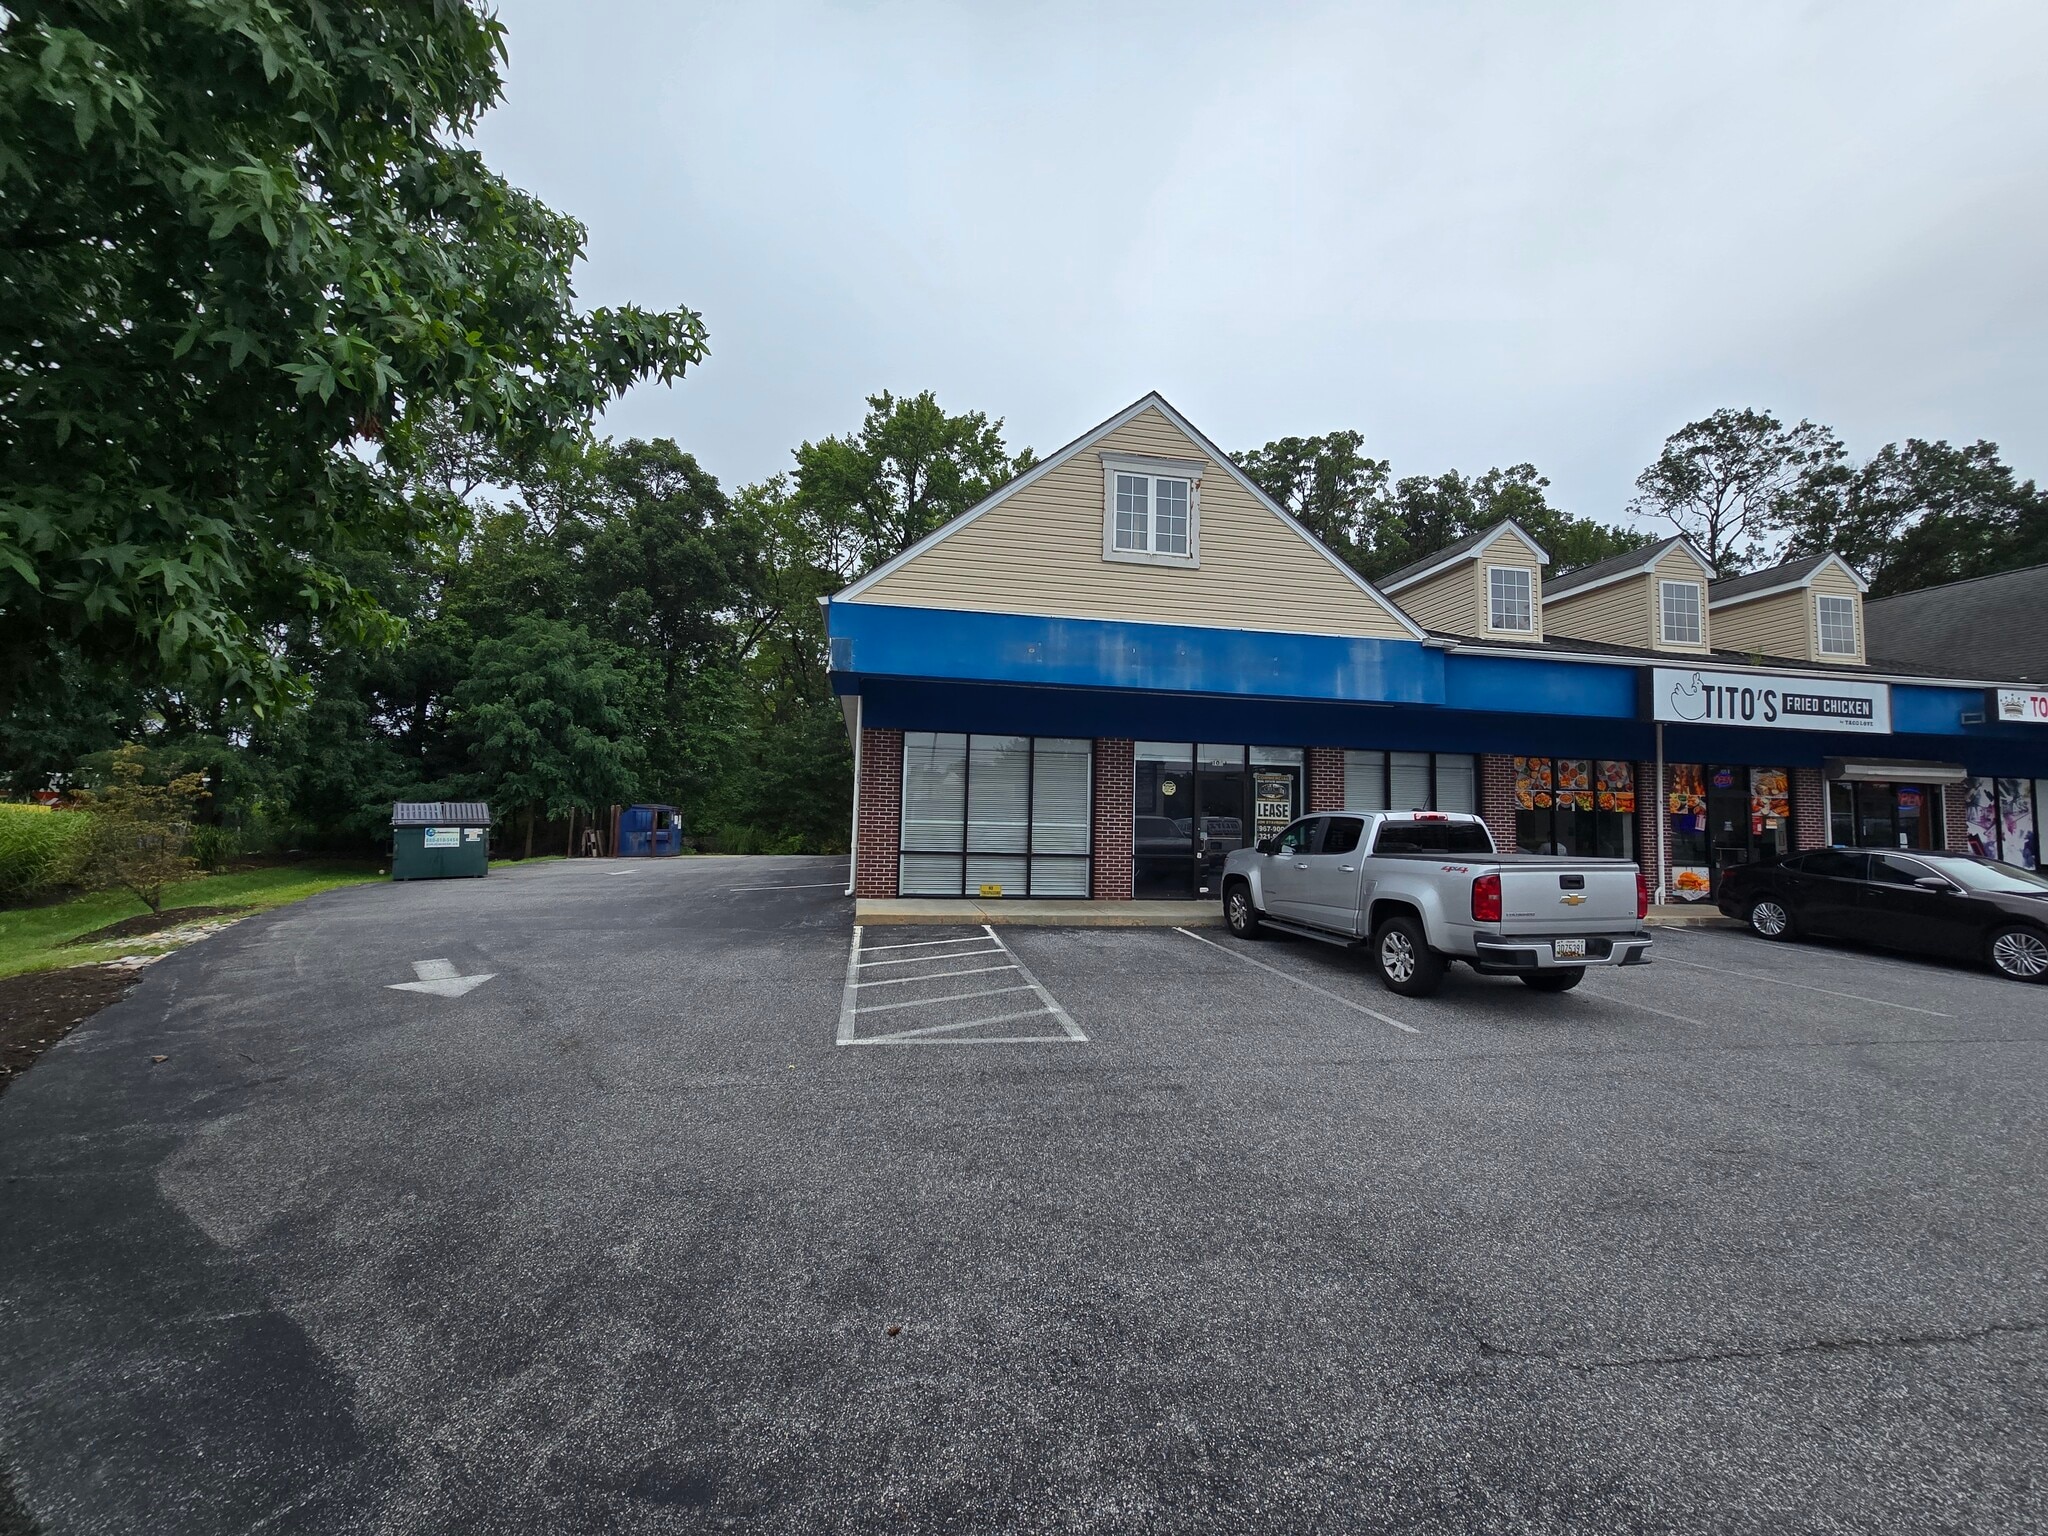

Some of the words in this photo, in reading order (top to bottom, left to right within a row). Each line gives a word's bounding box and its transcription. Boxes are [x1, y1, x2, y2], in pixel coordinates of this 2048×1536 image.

[1702, 685, 1777, 722] TITO'S
[1786, 696, 1819, 712] FRIED
[1823, 699, 1870, 715] CHICKEN
[1257, 803, 1289, 818] LEASE
[1440, 866, 1470, 874] 4x4
